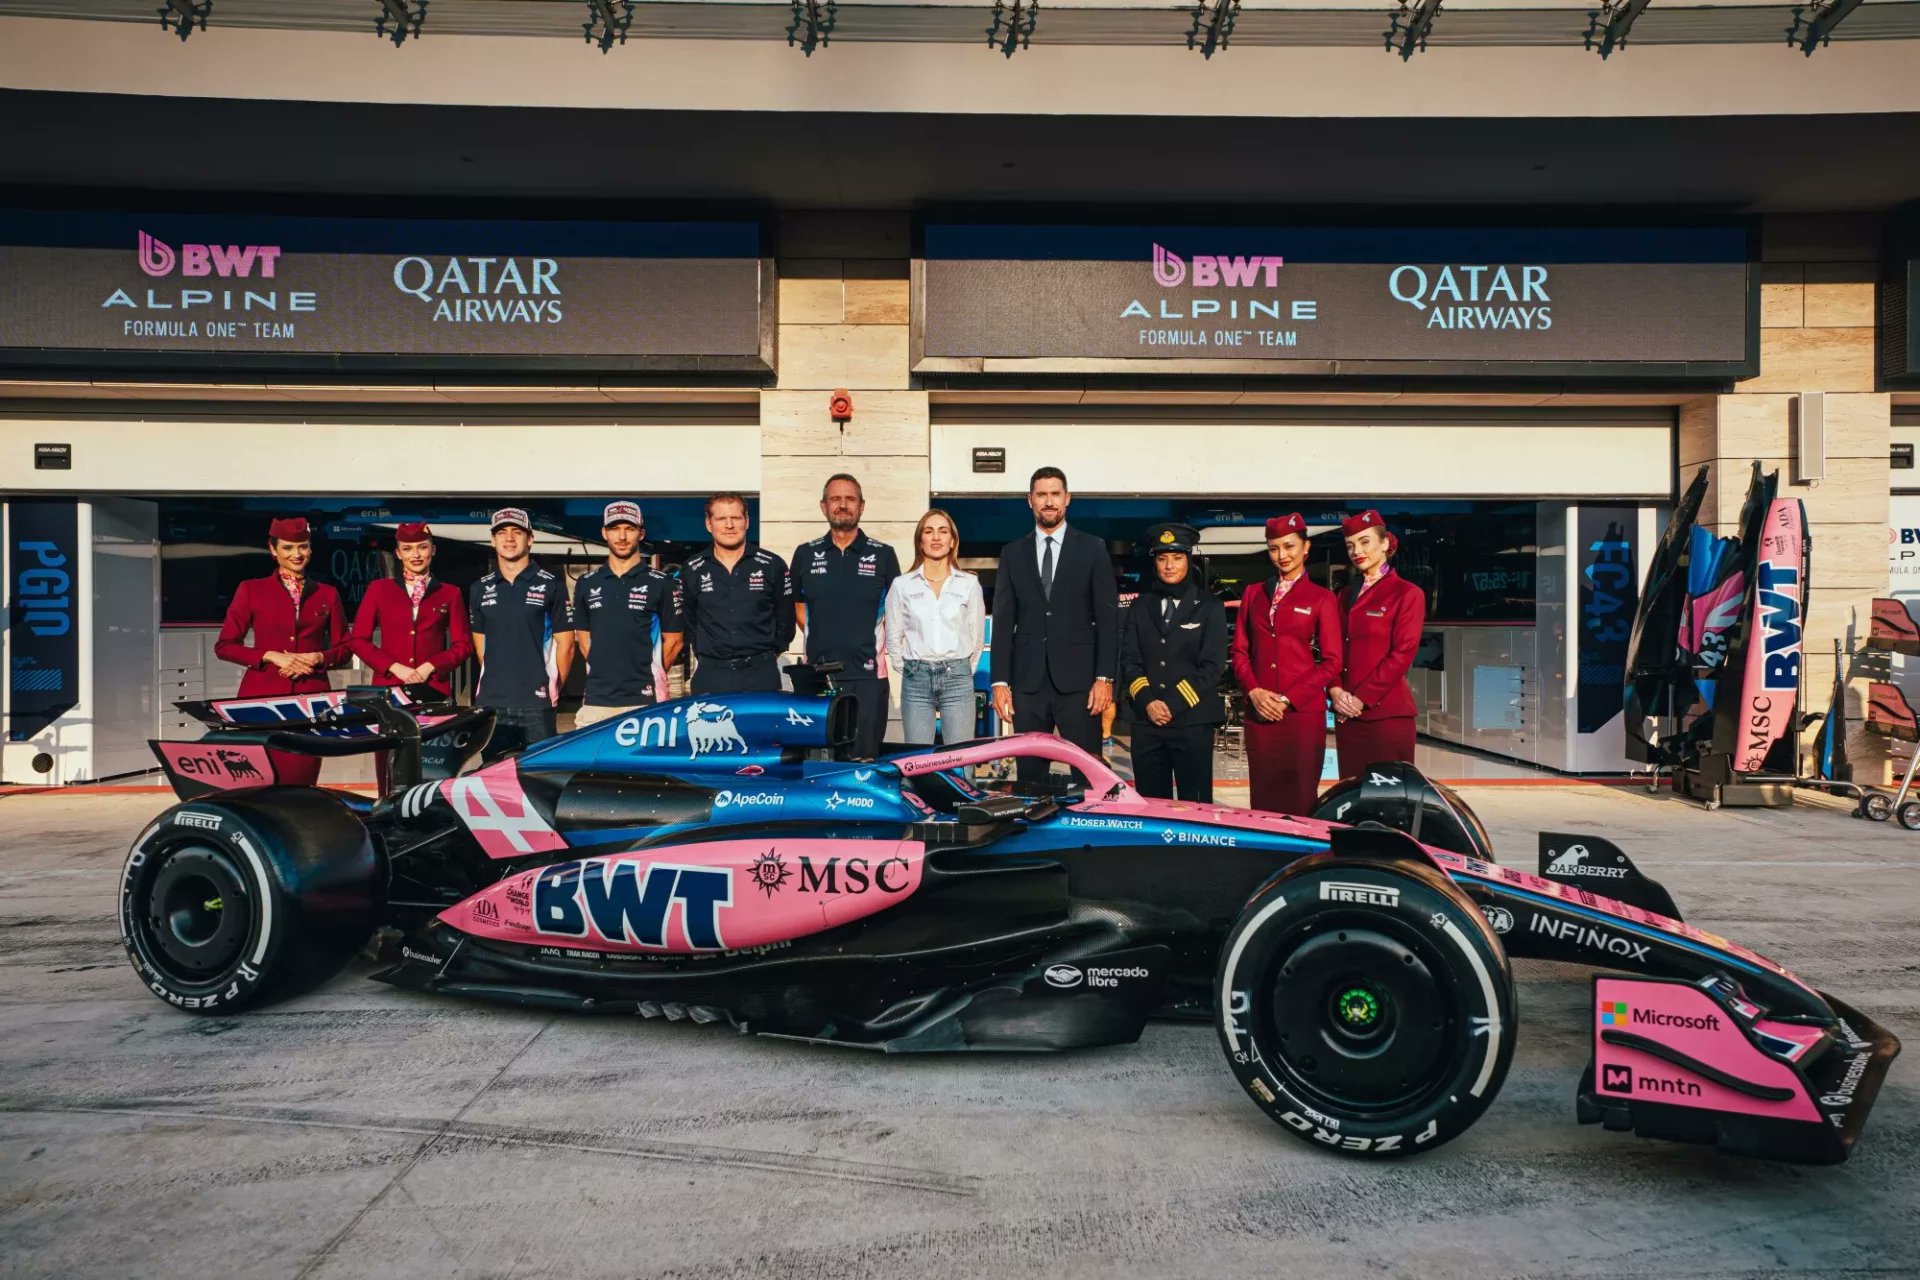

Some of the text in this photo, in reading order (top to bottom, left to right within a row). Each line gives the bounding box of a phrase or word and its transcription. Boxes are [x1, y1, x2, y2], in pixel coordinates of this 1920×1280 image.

[181, 243, 281, 278] BWT
[1192, 255, 1284, 288] BWT
[393, 256, 561, 303] QATAR
[1388, 265, 1551, 310] QATAR
[101, 288, 317, 312] ALPINE
[433, 299, 562, 323] AIRWAYS
[1119, 299, 1317, 320] ALPINE
[124, 320, 198, 337] FORMULA
[253, 323, 295, 338] TEAM
[1426, 306, 1552, 330] AIRWAYS
[1139, 330, 1207, 345] FORMULA
[1258, 331, 1297, 346] TEAM
[19, 541, 71, 636] PG10
[1757, 560, 1803, 691] BWT
[1700, 631, 1726, 668] 43
[615, 707, 683, 748] eni
[1749, 696, 1772, 751] MSC
[178, 752, 221, 777] eni
[732, 792, 784, 806] ApeCoin
[847, 797, 874, 808] MODO
[174, 811, 223, 831] PIRELLI
[1178, 831, 1236, 847] BINANCE
[797, 855, 910, 894] MSC
[1547, 863, 1629, 879] OAKBERRY
[533, 857, 735, 950] BWT
[1319, 881, 1401, 907] PIRELLI
[473, 900, 500, 920] ADA
[1529, 912, 1651, 962] INFINOX
[1087, 966, 1149, 977] mercado
[1087, 976, 1118, 987] libre
[150, 982, 219, 1009] ZERO
[1633, 1008, 1720, 1032] Microsoft
[1638, 1076, 1701, 1097] mntn
[1281, 1111, 1403, 1152] ZERO
[1415, 1120, 1438, 1144] P
